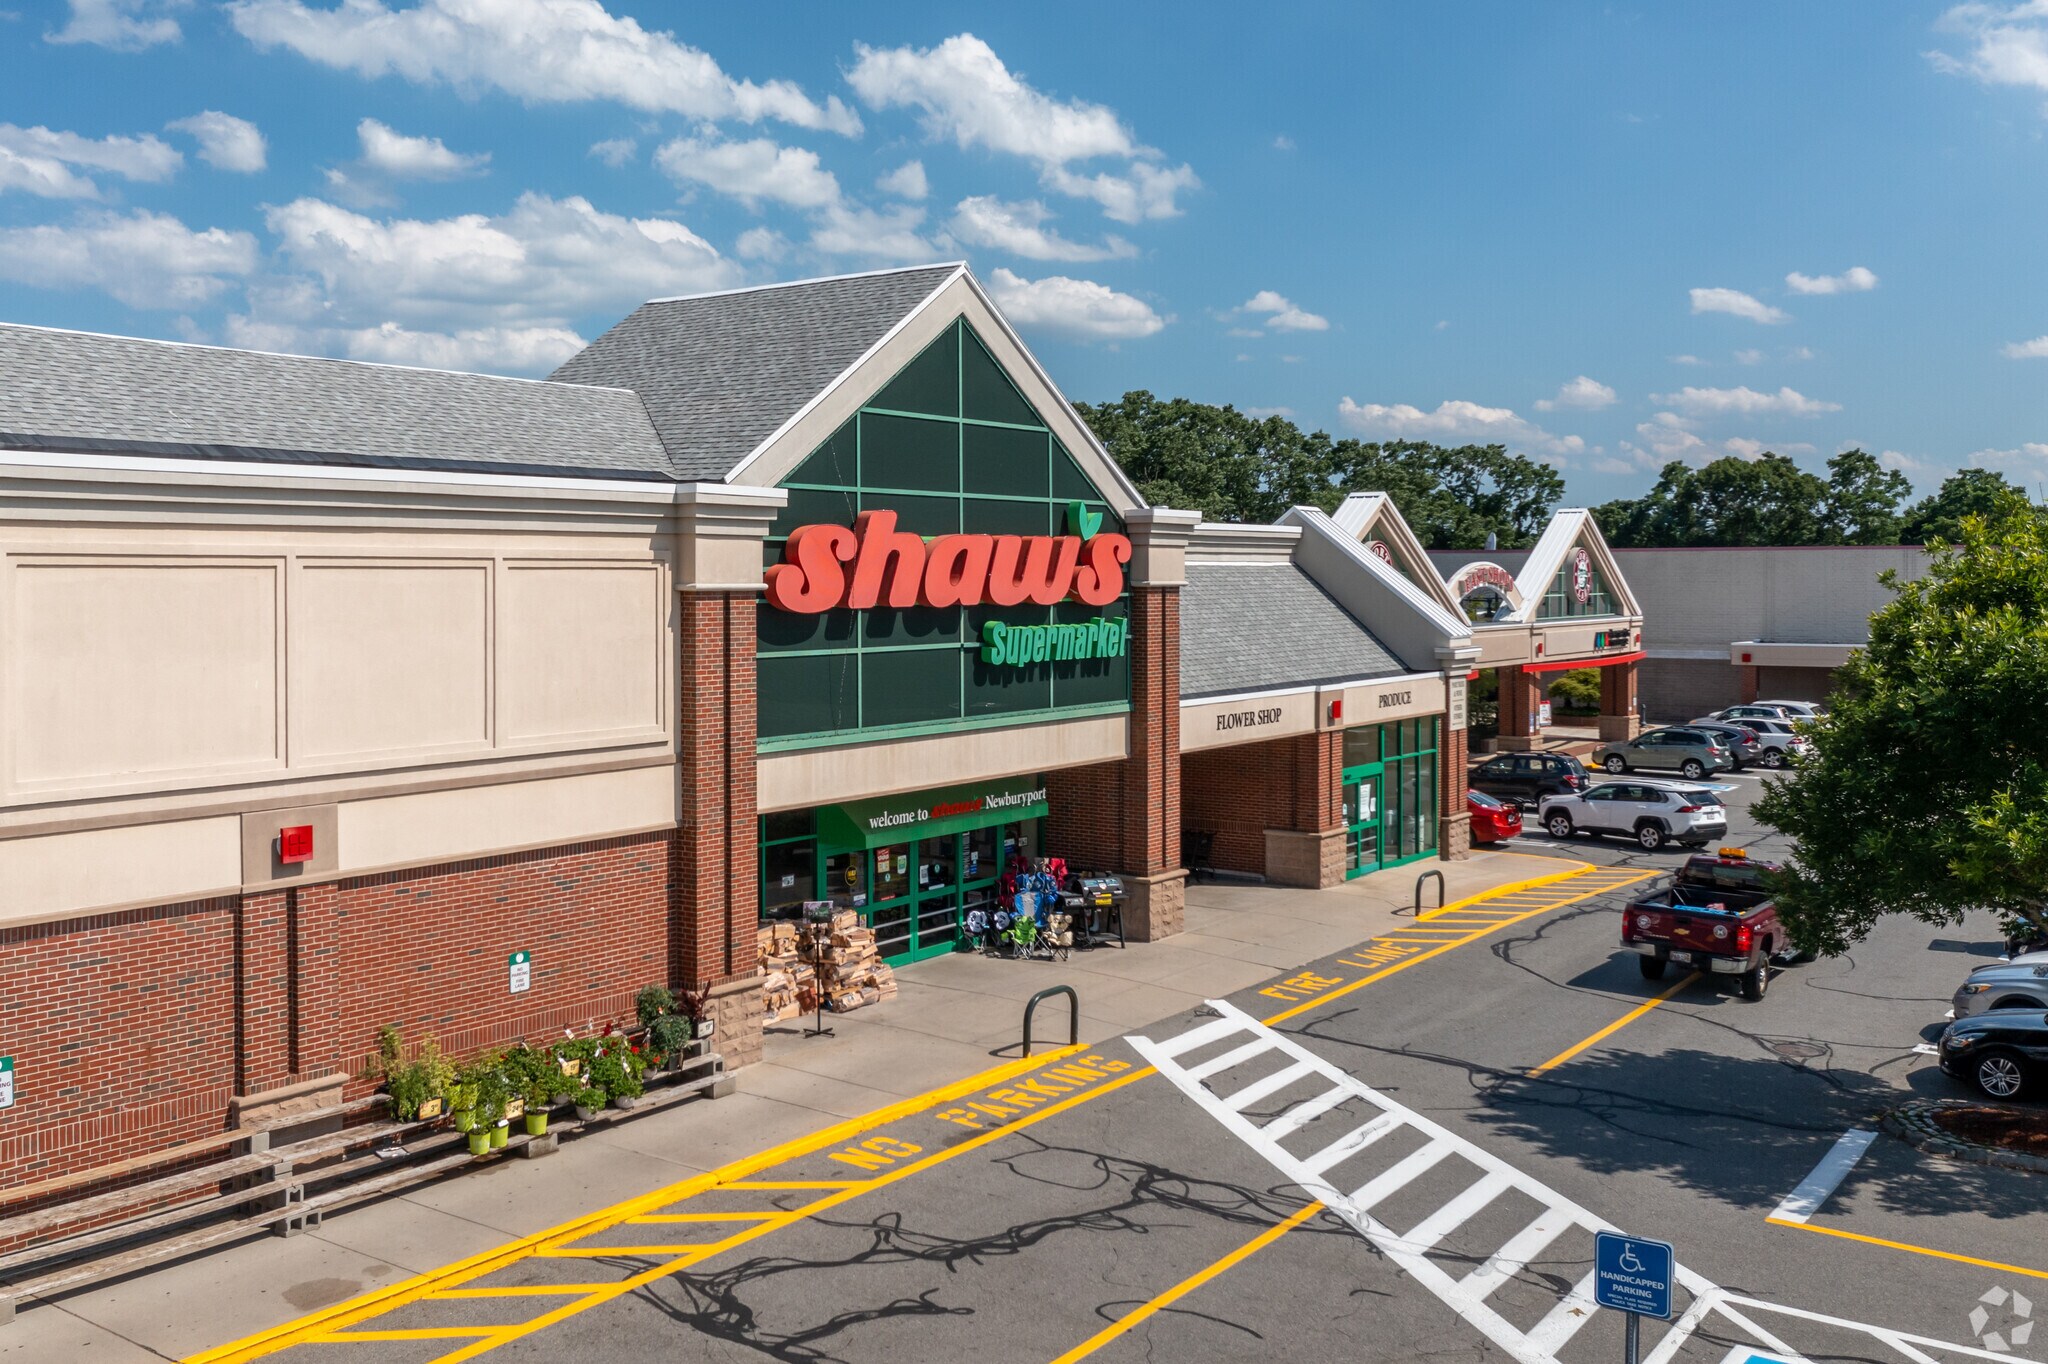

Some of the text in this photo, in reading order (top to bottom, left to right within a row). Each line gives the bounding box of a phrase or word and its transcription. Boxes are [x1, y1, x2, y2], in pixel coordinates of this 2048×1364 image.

[981, 617, 1128, 667] Supermarket
[1378, 690, 1412, 708] PRODUCE
[1216, 707, 1282, 731] FLOWER SHOP
[869, 811, 915, 829] welcome
[917, 808, 929, 821] to
[985, 787, 1046, 810] Newburyport
[1258, 941, 1422, 1001] FIRE LANE
[828, 1054, 1132, 1171] NO PARKING
[1600, 1270, 1665, 1290] HANDICAPPED
[1612, 1283, 1653, 1299] PARKING
